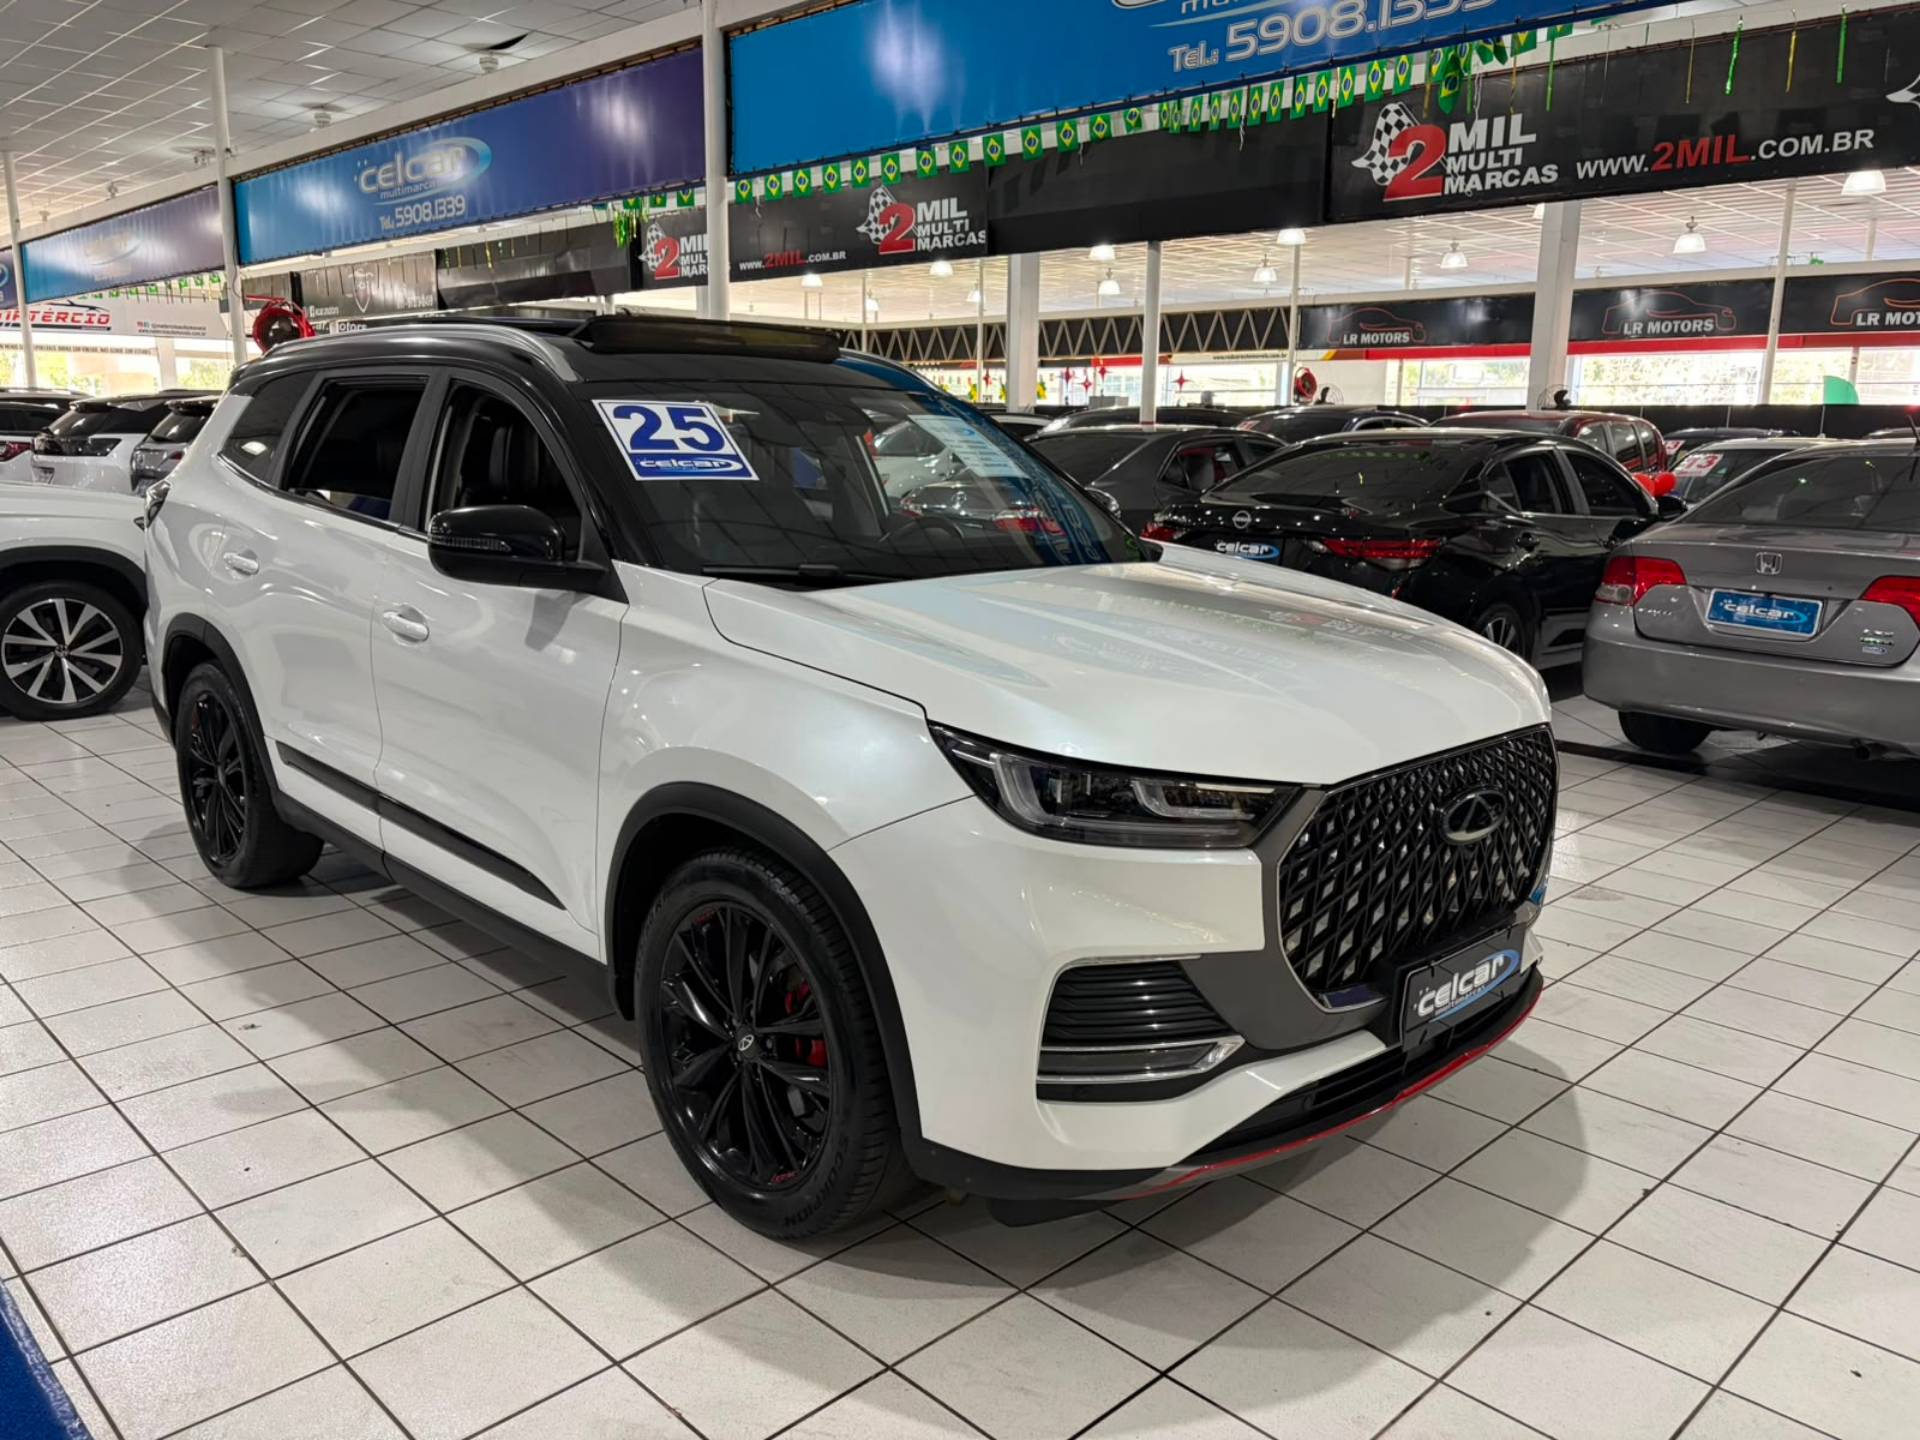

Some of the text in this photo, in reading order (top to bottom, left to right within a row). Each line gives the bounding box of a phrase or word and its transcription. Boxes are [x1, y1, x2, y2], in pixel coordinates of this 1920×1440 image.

[1448, 114, 1537, 154] MIL
[359, 146, 467, 193] celcar
[1383, 124, 1447, 202] 2
[1446, 147, 1523, 175] MULTI
[1444, 164, 1559, 195] MARCAS
[395, 194, 466, 228] 5908.1339
[917, 197, 968, 223] MIL
[878, 202, 916, 255] 2
[916, 218, 970, 239] MULTI
[917, 229, 986, 251] MARCAS
[655, 235, 680, 280] 2
[1623, 318, 1714, 336] LR MOTORS
[1856, 312, 1880, 326] LR
[1343, 331, 1410, 345] LR MOTORS
[613, 405, 725, 452] 25
[639, 458, 727, 469] celcar
[1216, 541, 1269, 554] celcar
[1723, 603, 1795, 619] celcar
[1418, 953, 1505, 1017] celcar
